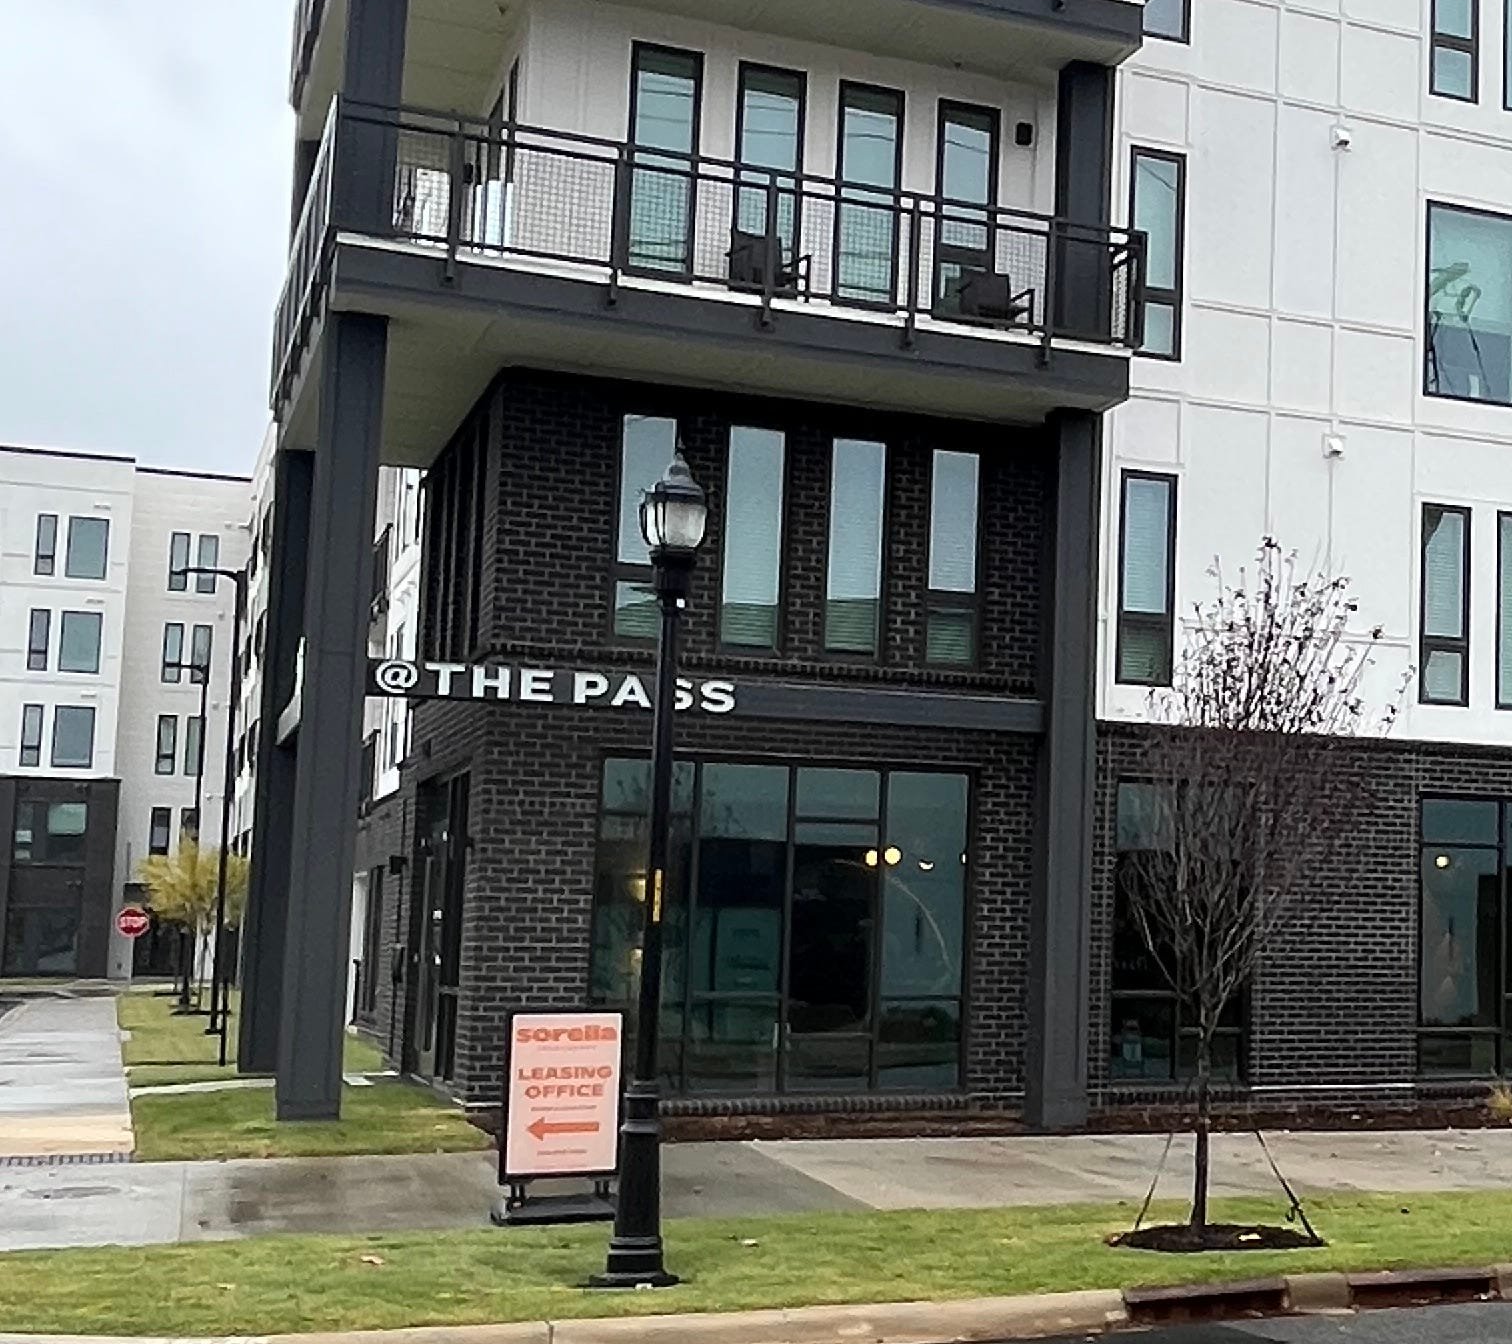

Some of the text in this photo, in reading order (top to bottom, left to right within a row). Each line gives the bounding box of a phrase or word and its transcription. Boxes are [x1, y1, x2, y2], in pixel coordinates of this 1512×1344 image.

[573, 672, 737, 713] PASS
[518, 1066, 614, 1081] LEASING
[524, 1083, 605, 1099] OFFICE
